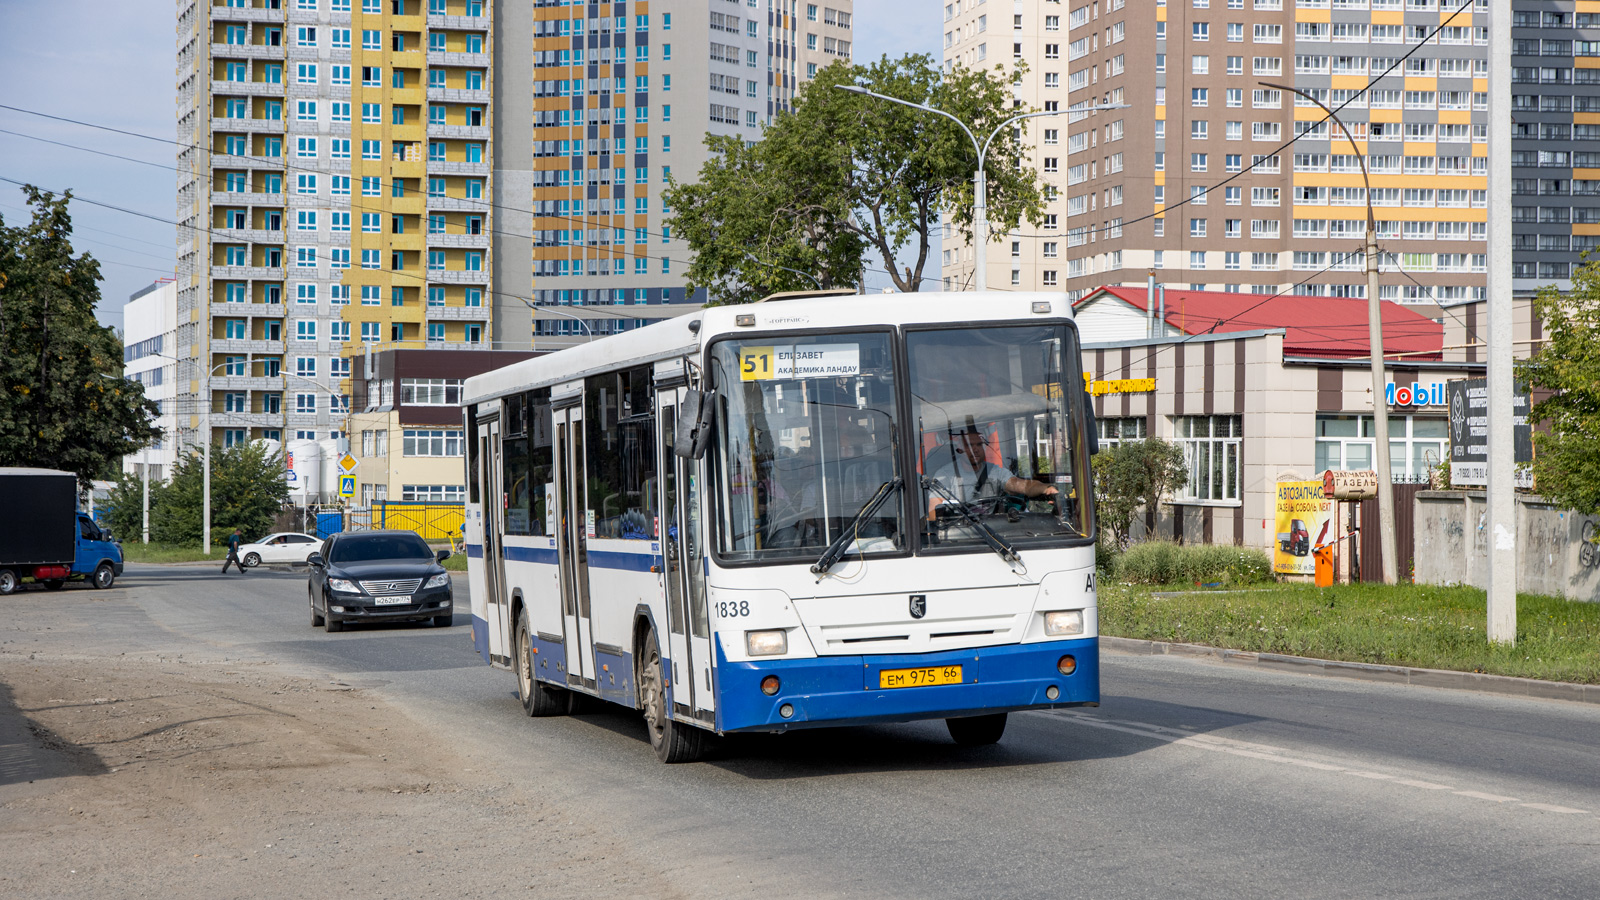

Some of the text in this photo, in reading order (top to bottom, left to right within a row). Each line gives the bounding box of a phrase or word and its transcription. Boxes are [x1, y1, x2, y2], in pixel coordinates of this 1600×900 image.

[778, 352, 824, 360] ЕЛИЗАВЕТ
[744, 354, 769, 373] 51
[778, 366, 825, 374] АКАДЕМИКА
[1278, 486, 1325, 500] АВТОЗАПЧАС
[1319, 503, 1331, 512] NEXT
[715, 600, 750, 618] 1838
[887, 674, 905, 685] ЕМ
[910, 669, 936, 684] 975
[943, 667, 957, 678] 66
